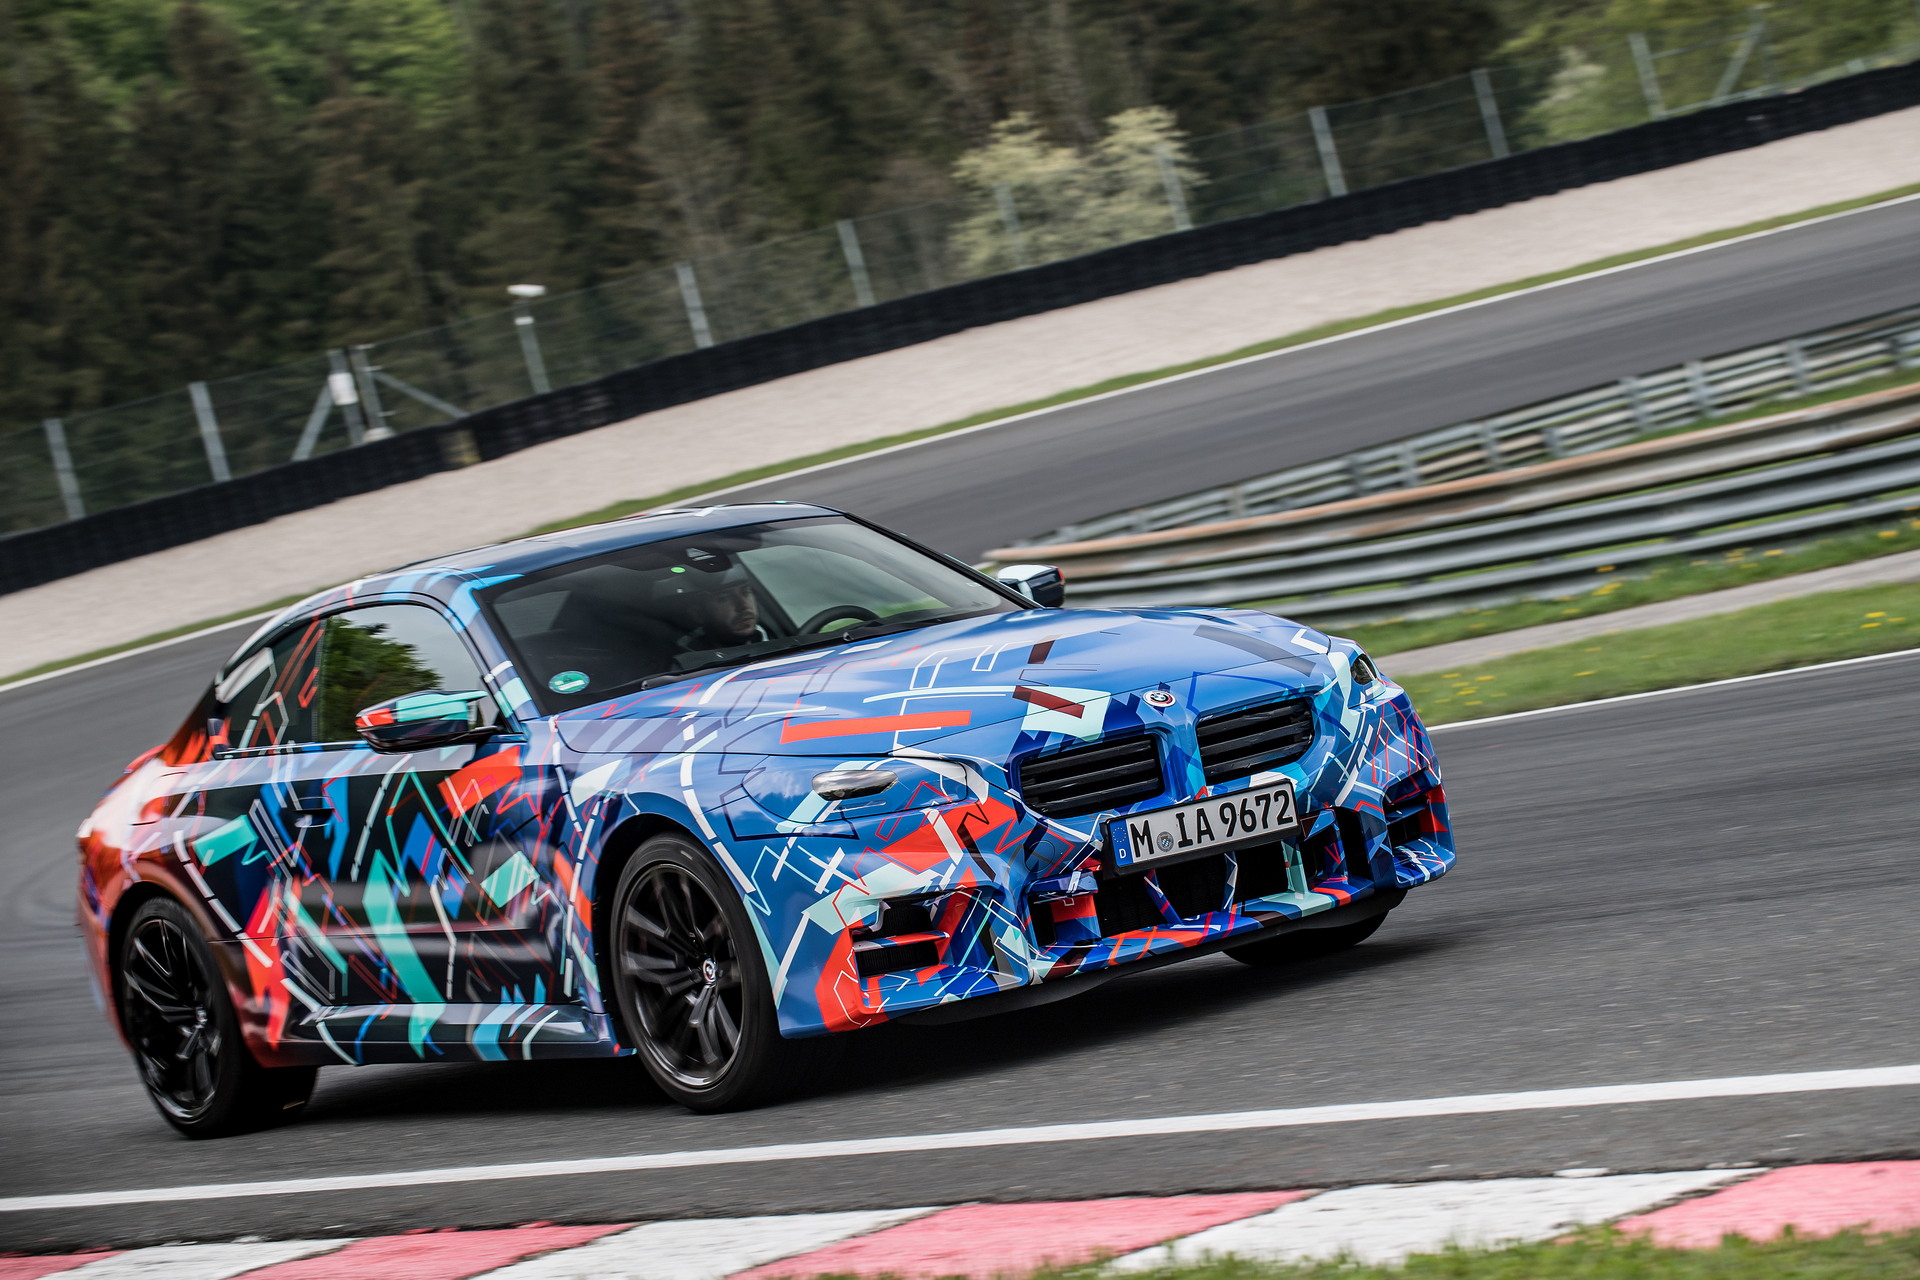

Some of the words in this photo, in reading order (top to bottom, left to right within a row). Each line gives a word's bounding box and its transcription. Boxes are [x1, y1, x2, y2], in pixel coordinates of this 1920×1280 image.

[1130, 819, 1154, 858] M
[1175, 808, 1215, 848] IA
[1219, 790, 1293, 837] 9672
[1119, 848, 1127, 859] D
